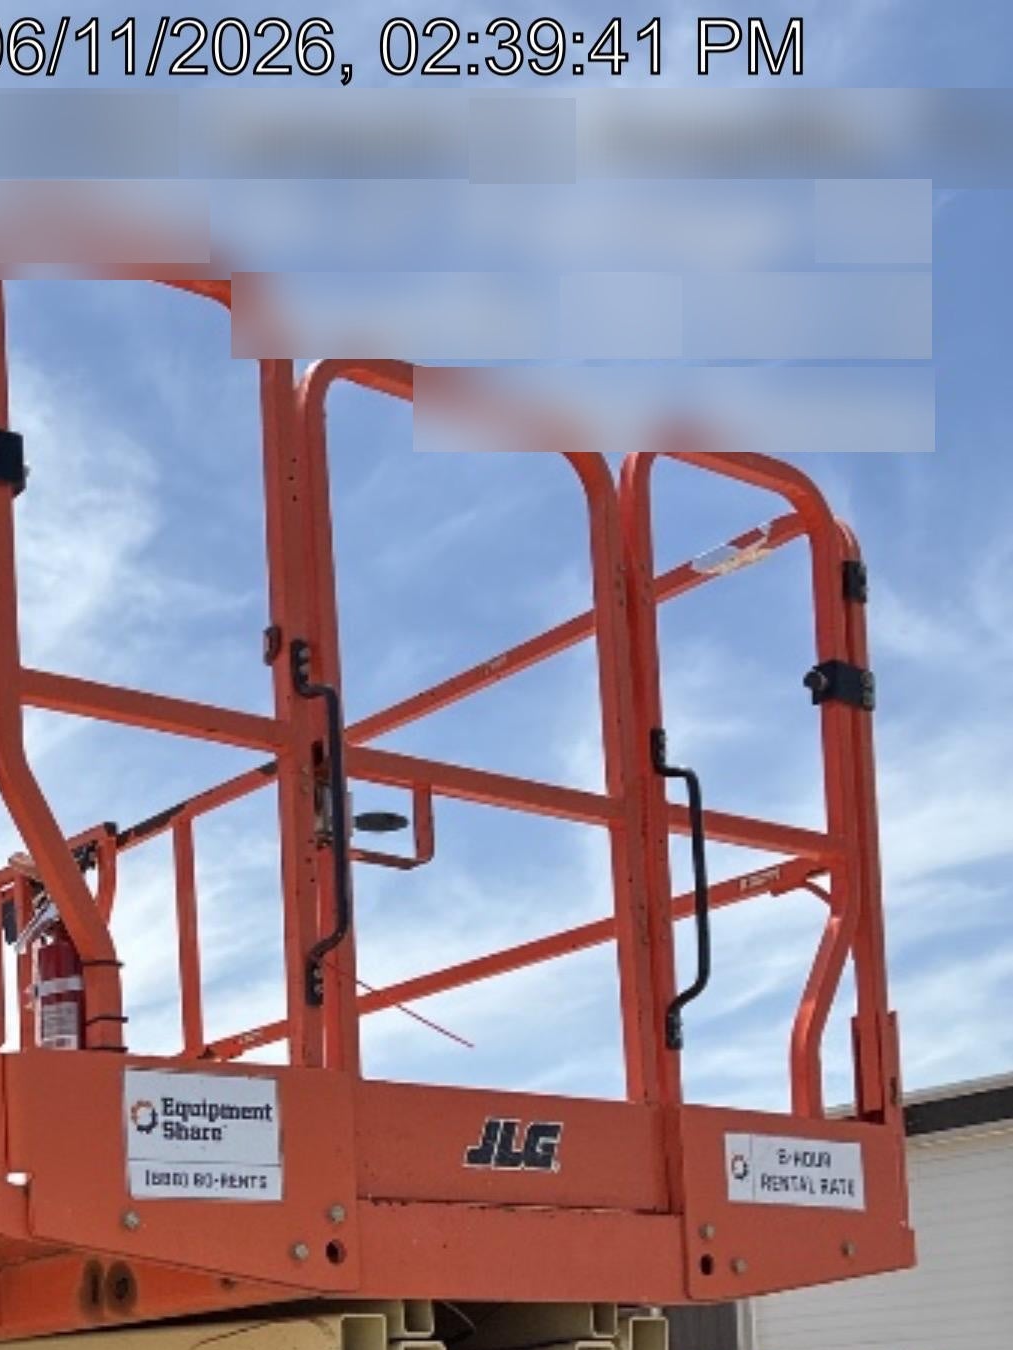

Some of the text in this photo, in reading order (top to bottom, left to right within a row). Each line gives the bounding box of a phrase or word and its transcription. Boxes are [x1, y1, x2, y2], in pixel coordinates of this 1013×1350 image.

[161, 1097, 273, 1122] Equipment
[461, 1116, 564, 1173] JLG
[760, 1173, 856, 1197] RENTAL RATE
